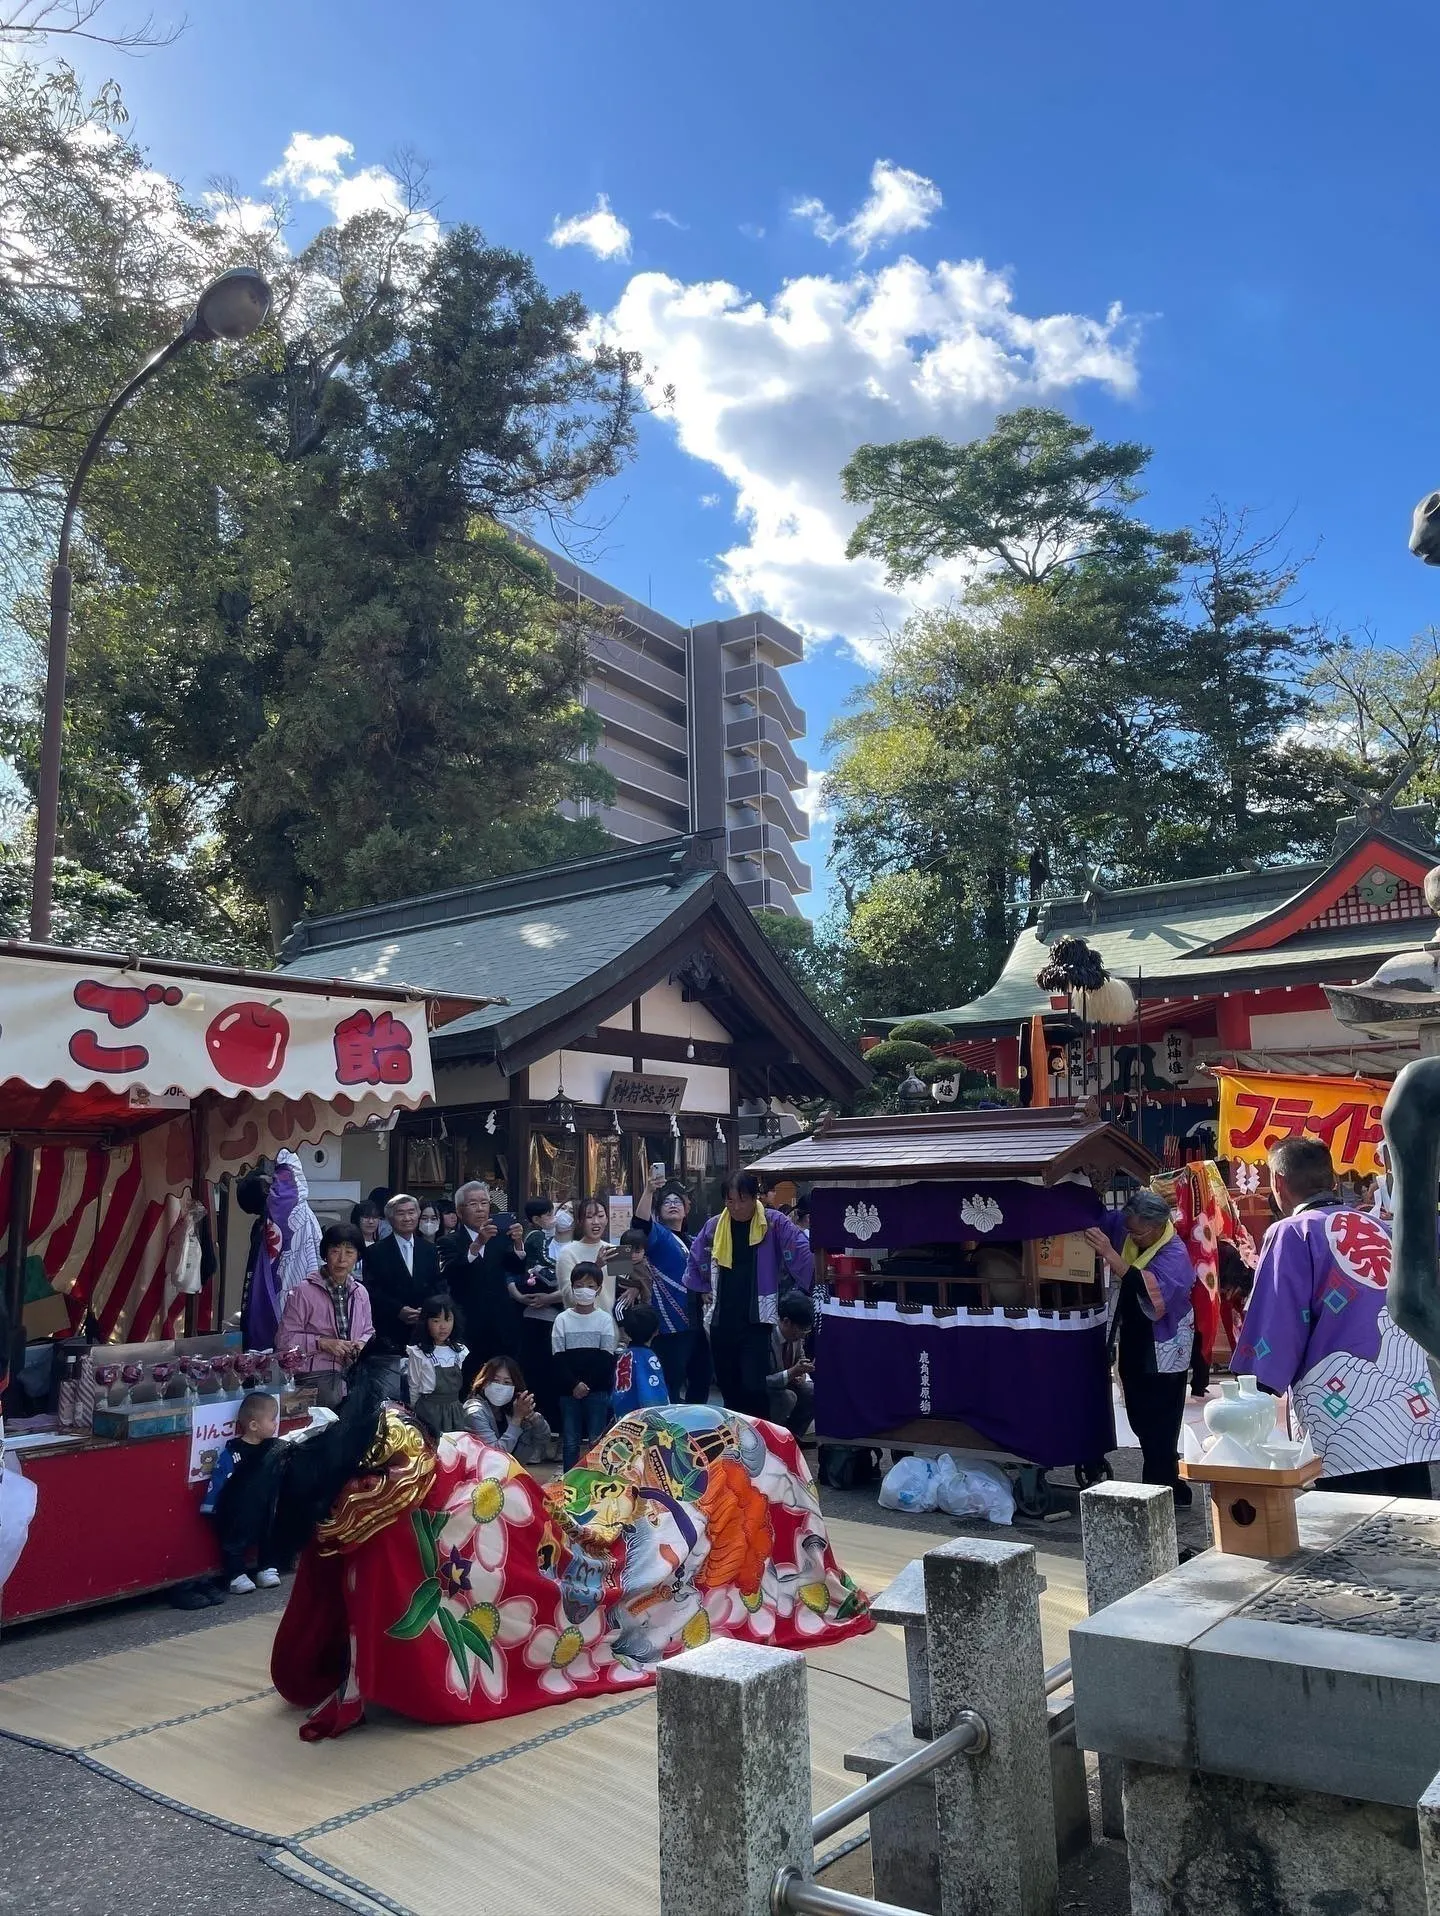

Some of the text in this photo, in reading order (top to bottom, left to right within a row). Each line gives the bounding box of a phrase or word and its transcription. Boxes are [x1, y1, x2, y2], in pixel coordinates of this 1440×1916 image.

[333, 1008, 413, 1085] 飴
[1330, 1212, 1392, 1288] 祭
[196, 1420, 242, 1440] りんご
